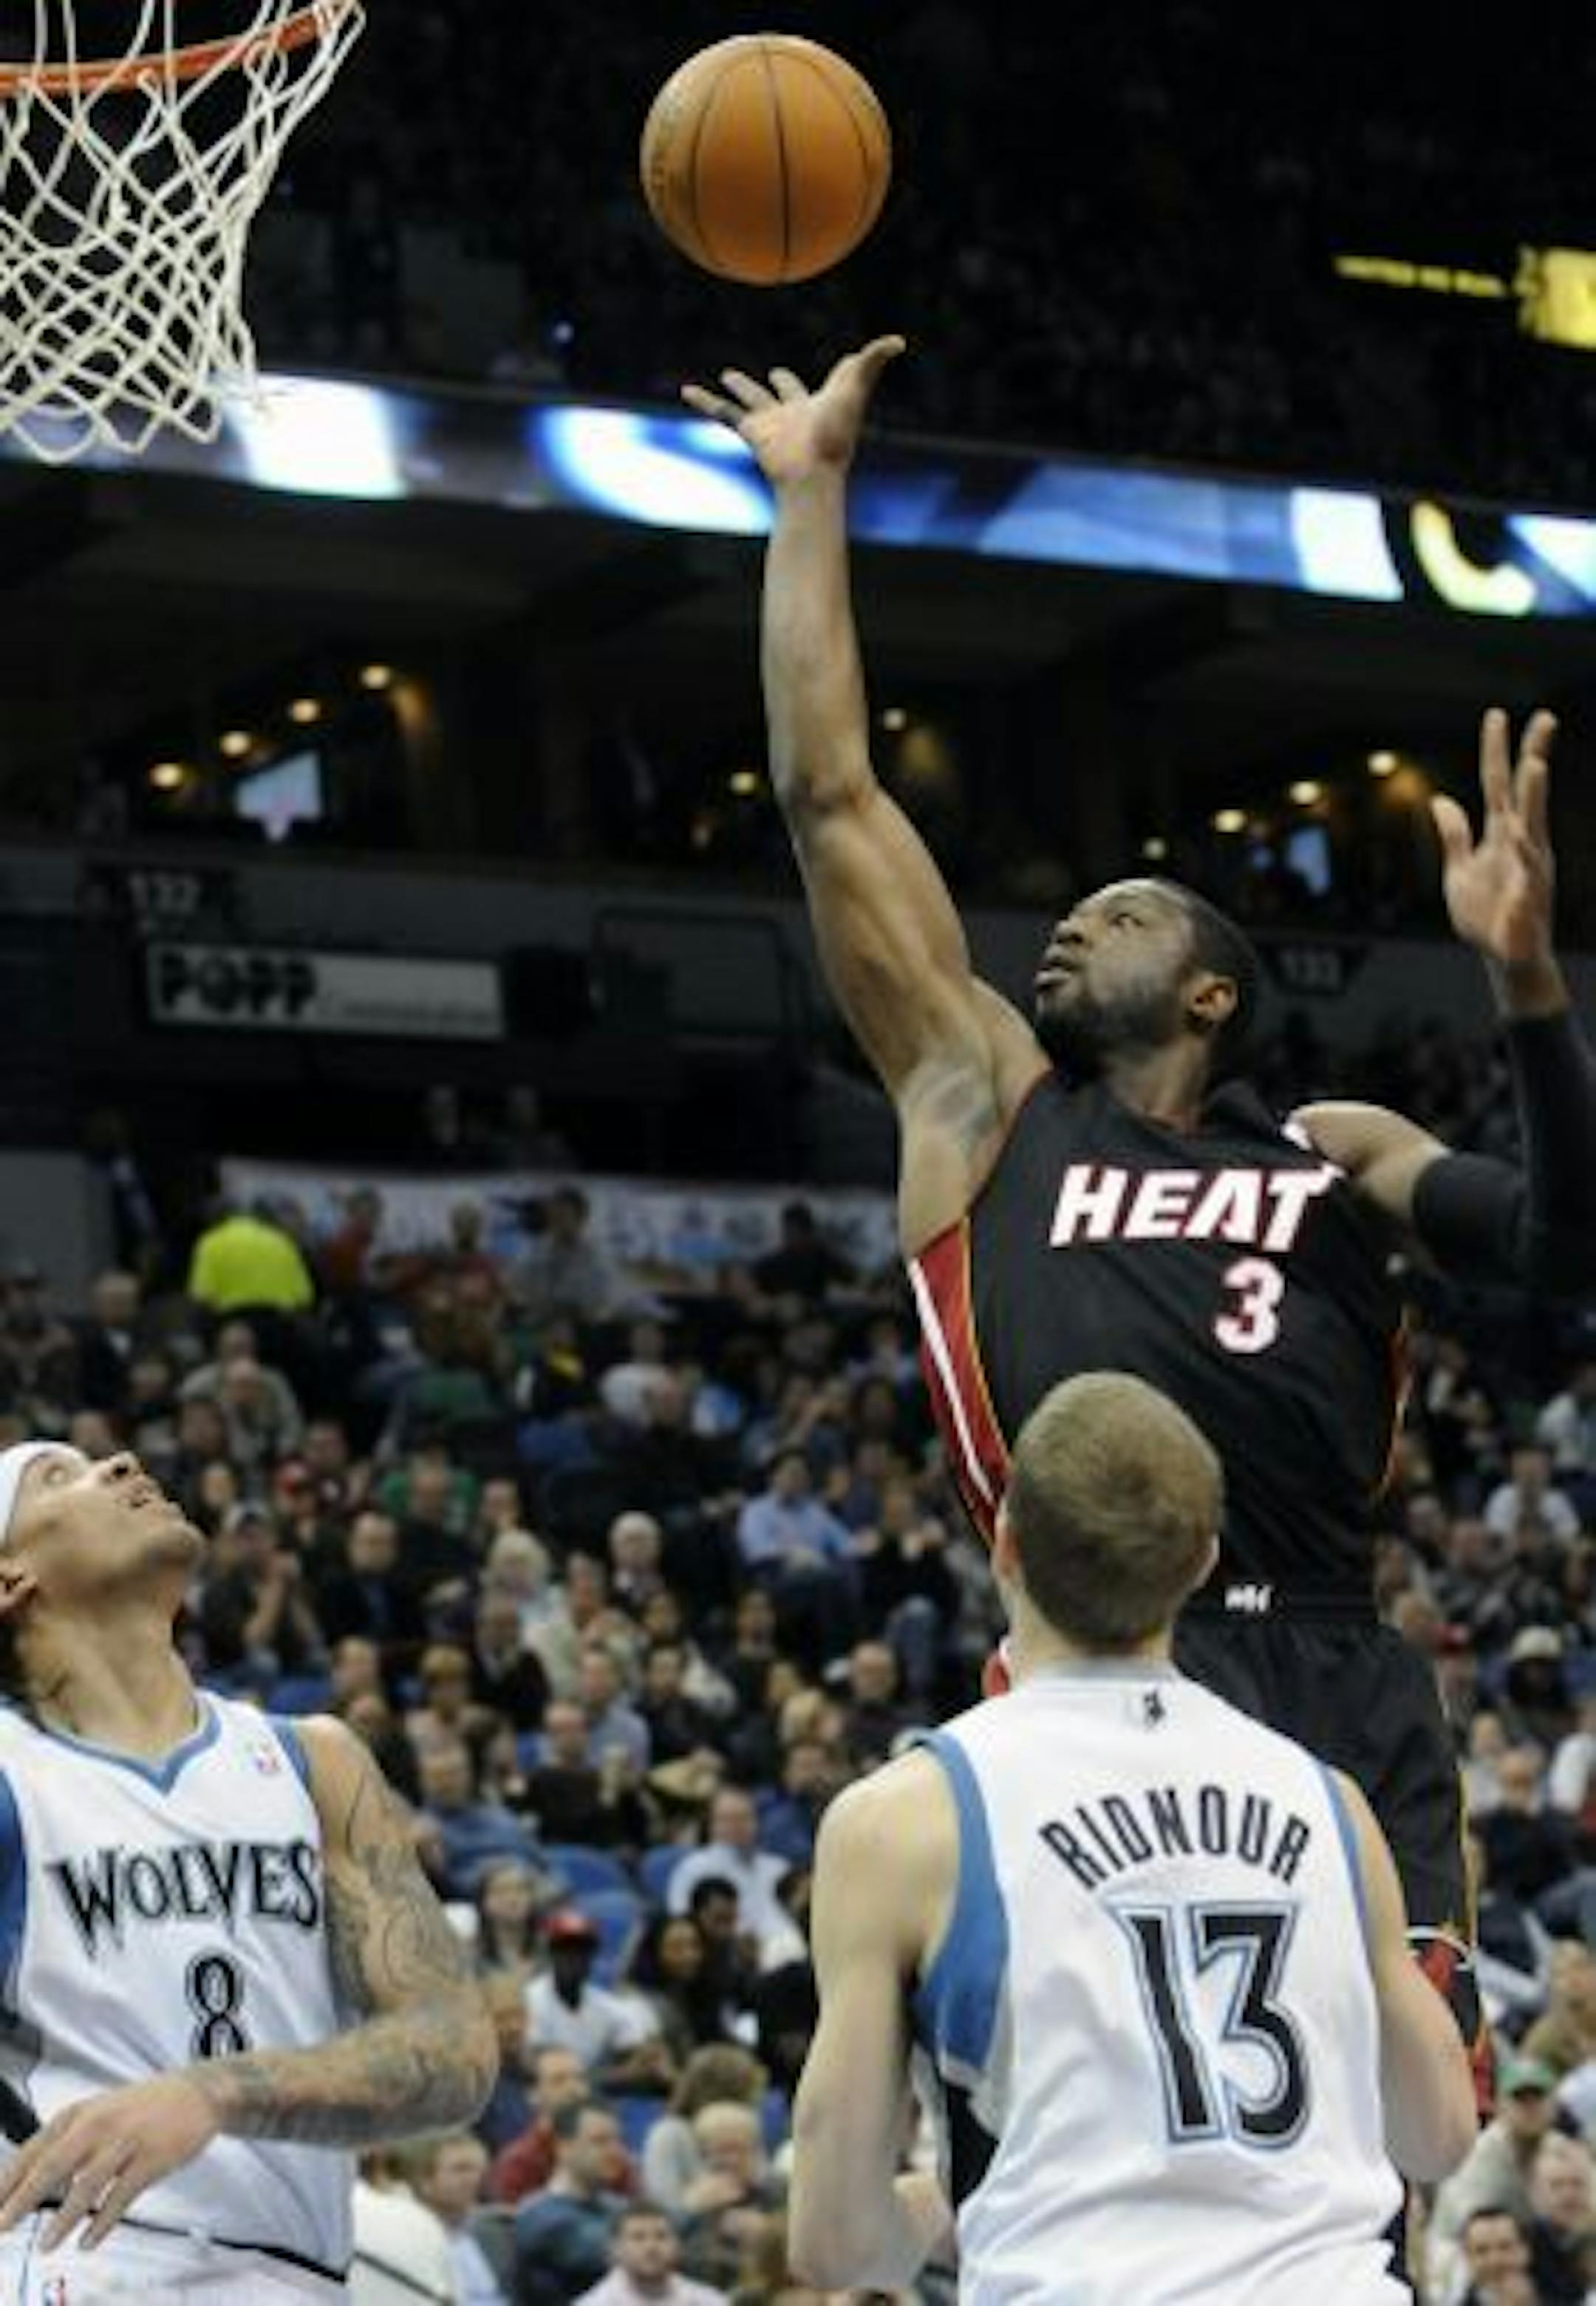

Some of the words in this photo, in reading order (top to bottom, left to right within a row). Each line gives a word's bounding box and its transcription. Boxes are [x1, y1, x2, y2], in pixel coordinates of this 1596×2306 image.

[160, 952, 316, 1014] POPP
[1049, 1164, 1345, 1253] HEAT
[1214, 1258, 1284, 1354] 3
[1038, 1784, 1310, 1891] RIDNOUR
[44, 1838, 319, 1961] WOLVES
[1099, 1900, 1311, 2149] 13
